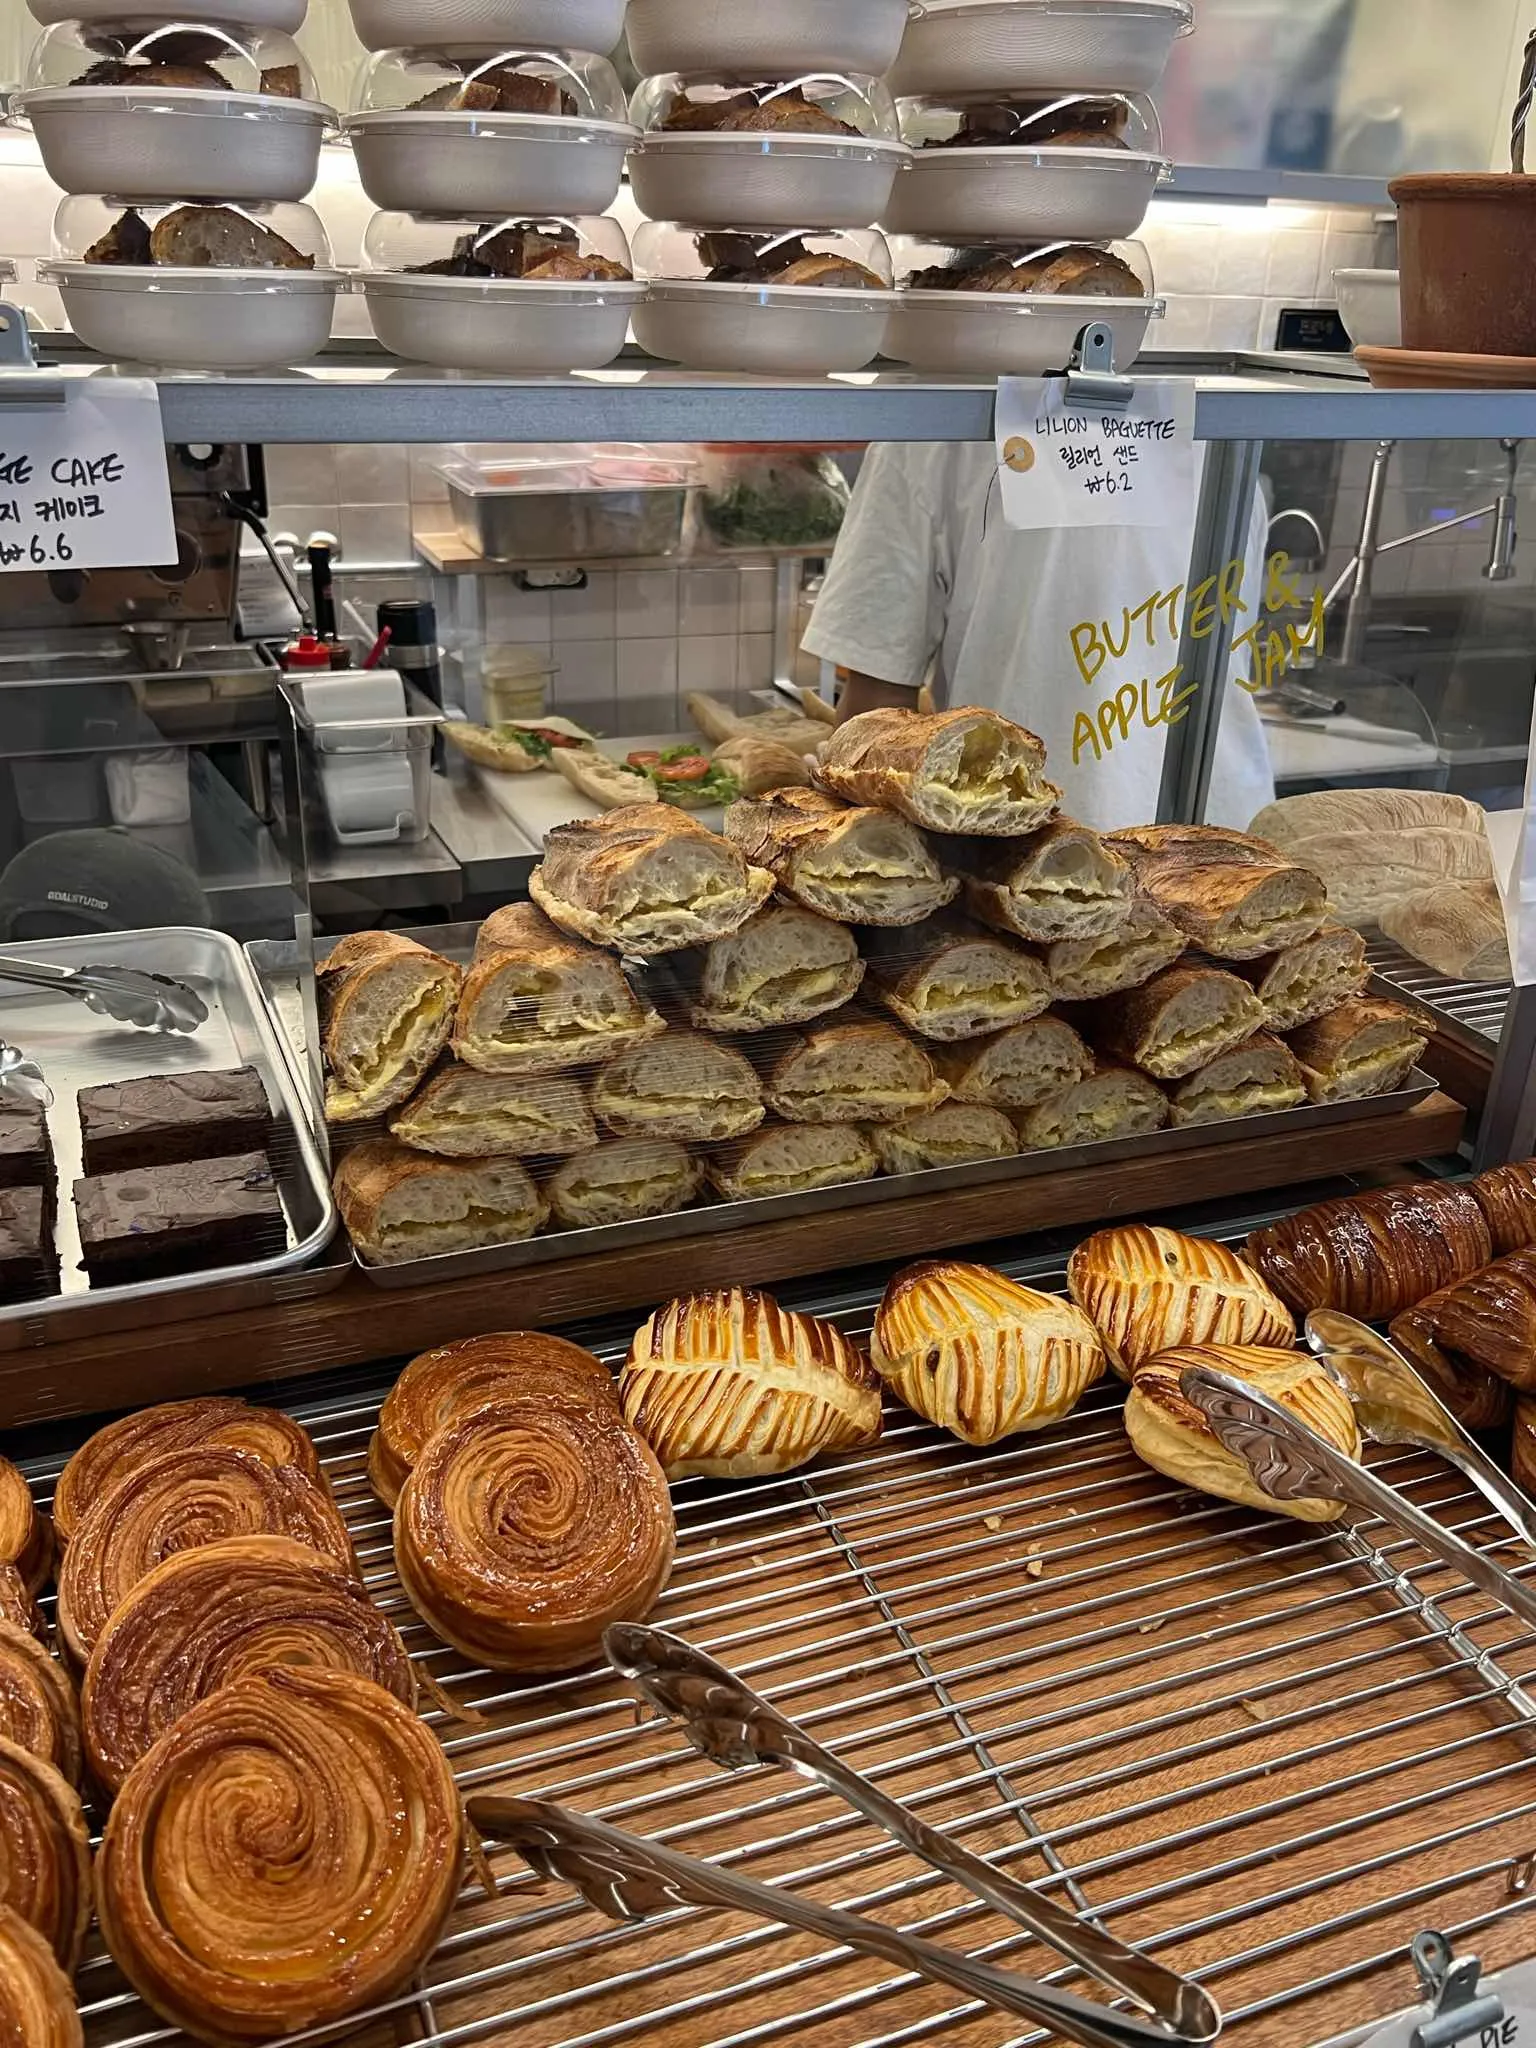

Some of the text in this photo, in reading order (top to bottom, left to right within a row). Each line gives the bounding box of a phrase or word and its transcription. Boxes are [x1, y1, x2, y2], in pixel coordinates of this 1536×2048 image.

[1035, 416, 1177, 441] LILION BAGUETTE
[51, 453, 125, 488] CAKE
[1058, 444, 1140, 470] 릴리언 샌드
[34, 494, 105, 523] 케이크
[1069, 551, 1302, 685] BUTTER &
[1072, 586, 1325, 765] APPLE JAM
